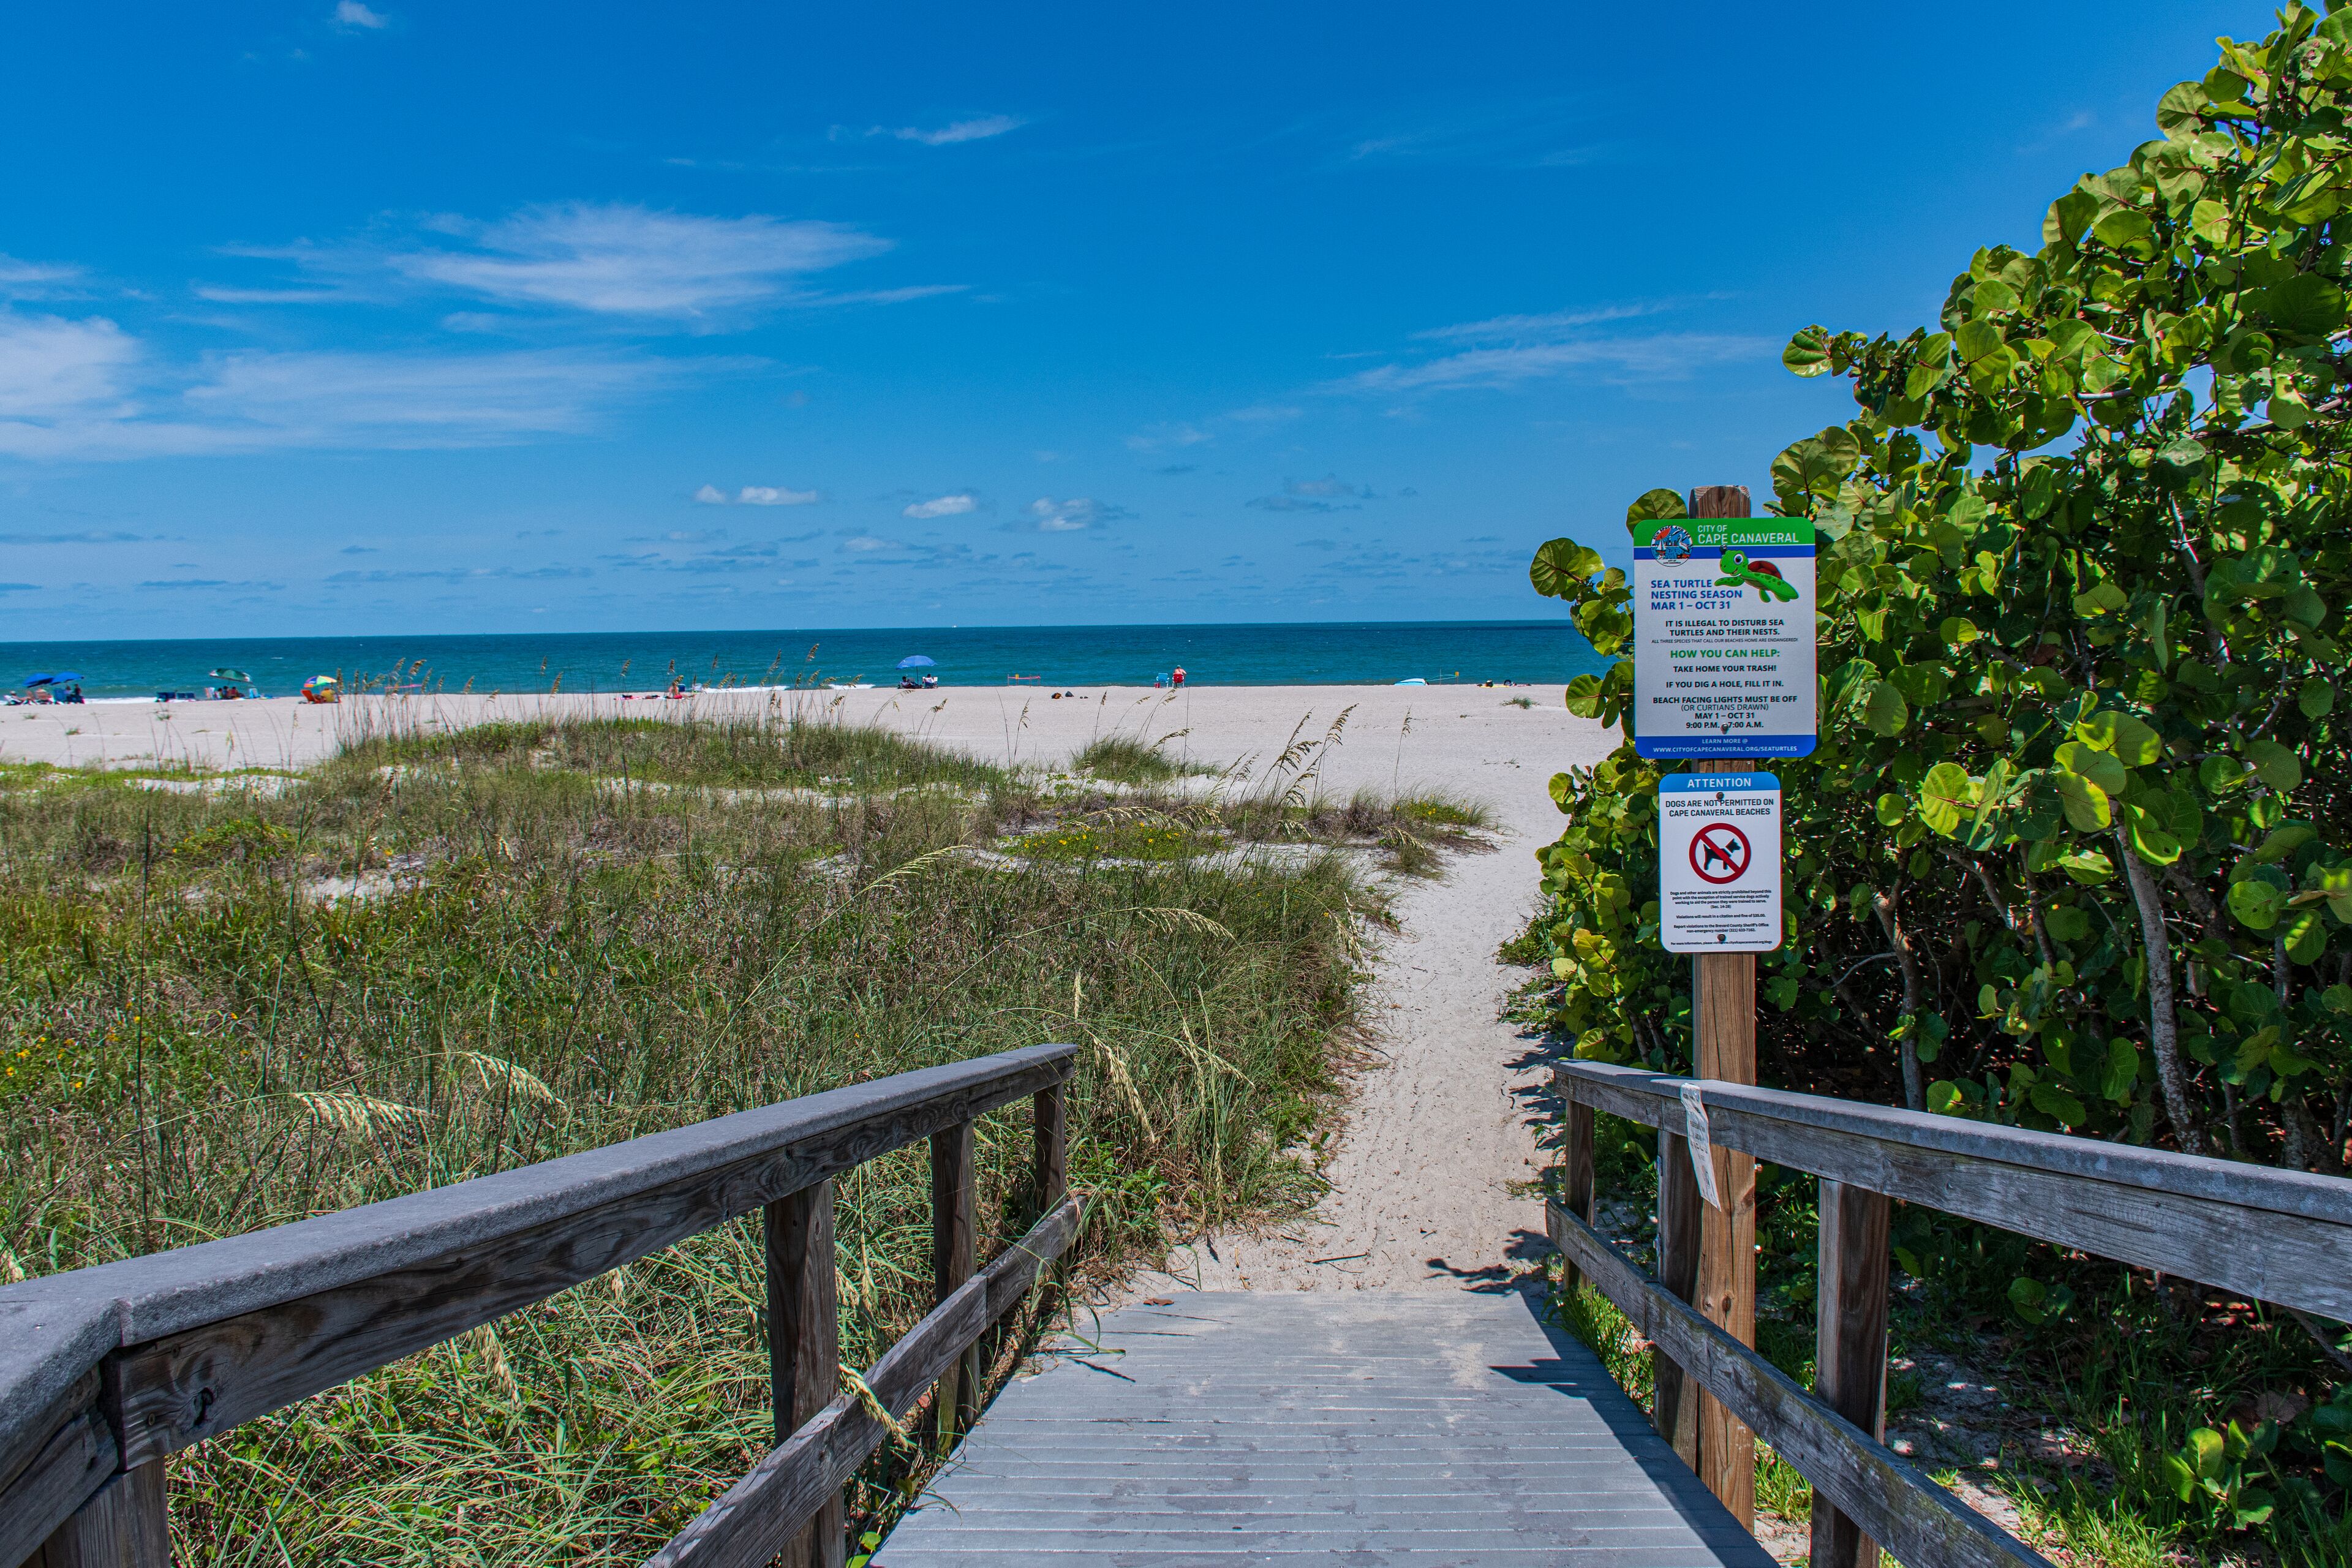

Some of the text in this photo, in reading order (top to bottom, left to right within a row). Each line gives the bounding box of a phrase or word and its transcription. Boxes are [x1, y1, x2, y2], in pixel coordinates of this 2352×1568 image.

[1698, 533, 1799, 544] CAPE CANAVERAL
[1651, 602, 1675, 610] MAR
[1752, 649, 1780, 657] HELP:
[1688, 778, 1751, 787] ATTENTION
